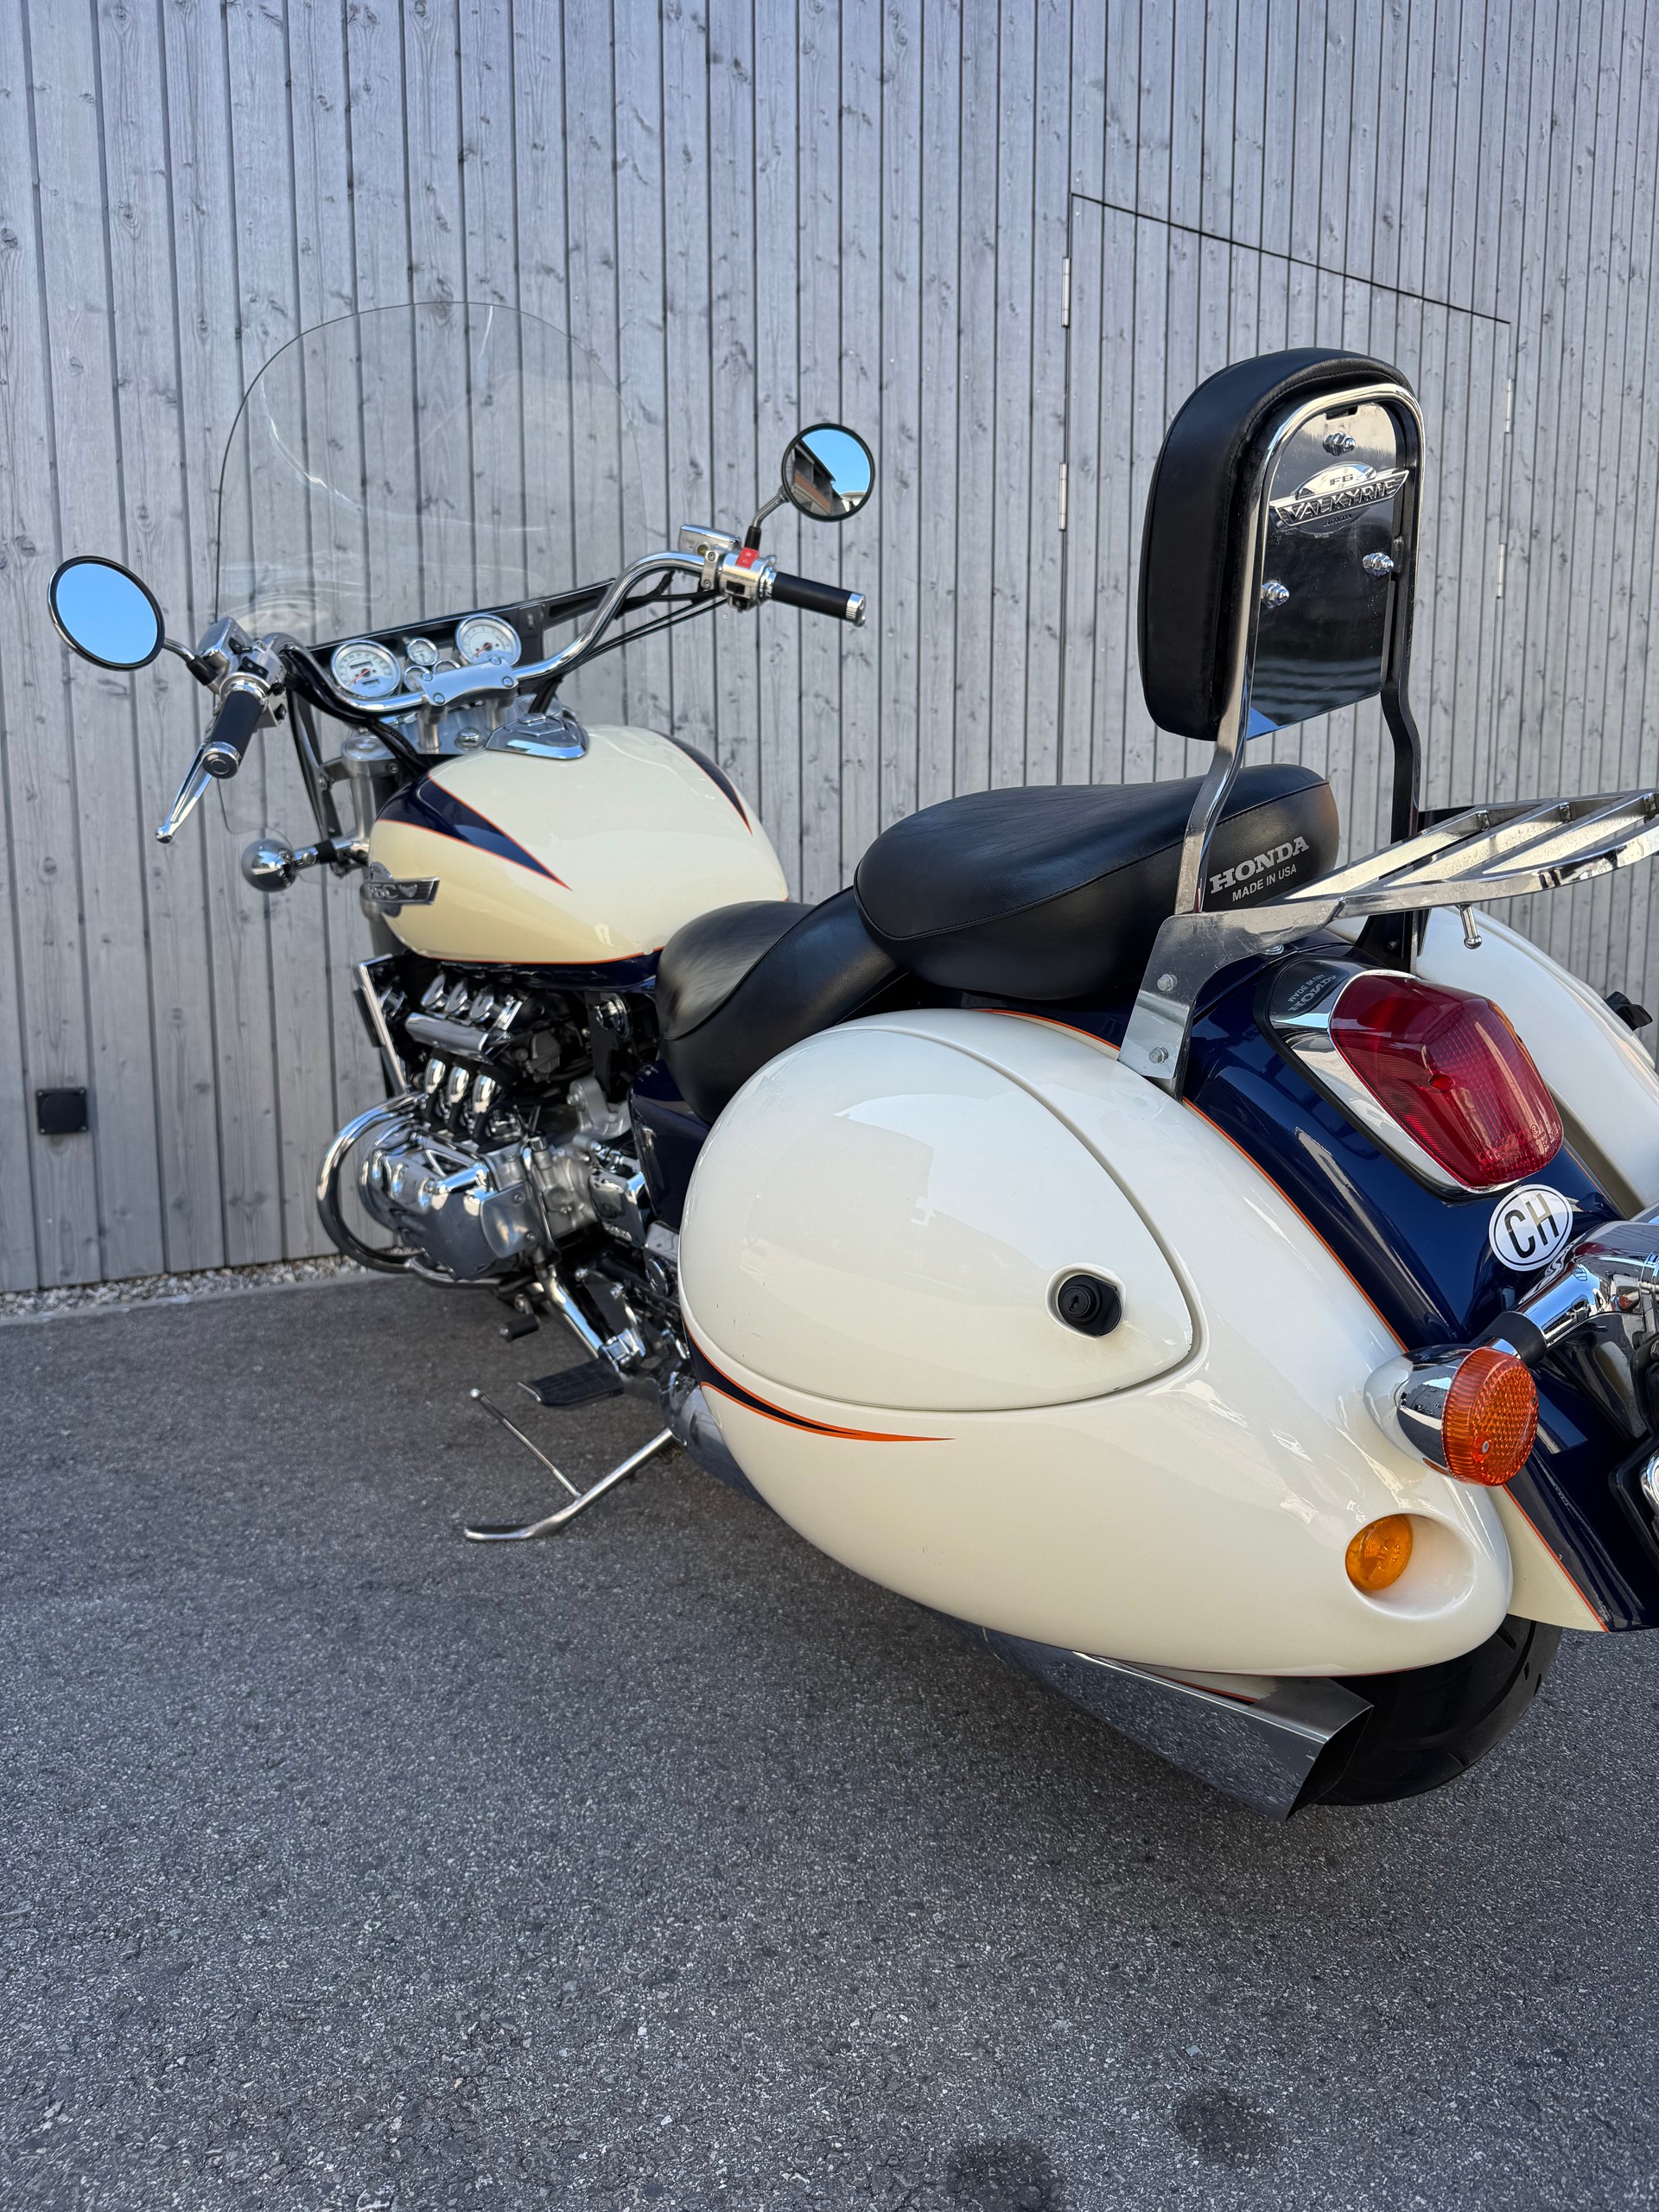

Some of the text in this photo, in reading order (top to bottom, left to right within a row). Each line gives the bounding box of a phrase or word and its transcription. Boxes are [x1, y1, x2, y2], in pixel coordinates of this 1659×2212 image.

[1283, 478, 1397, 522] VALKYRIE
[1210, 836, 1310, 894] HONDA
[1232, 864, 1297, 902] MADE IN USA
[1504, 1192, 1560, 1259] CH
